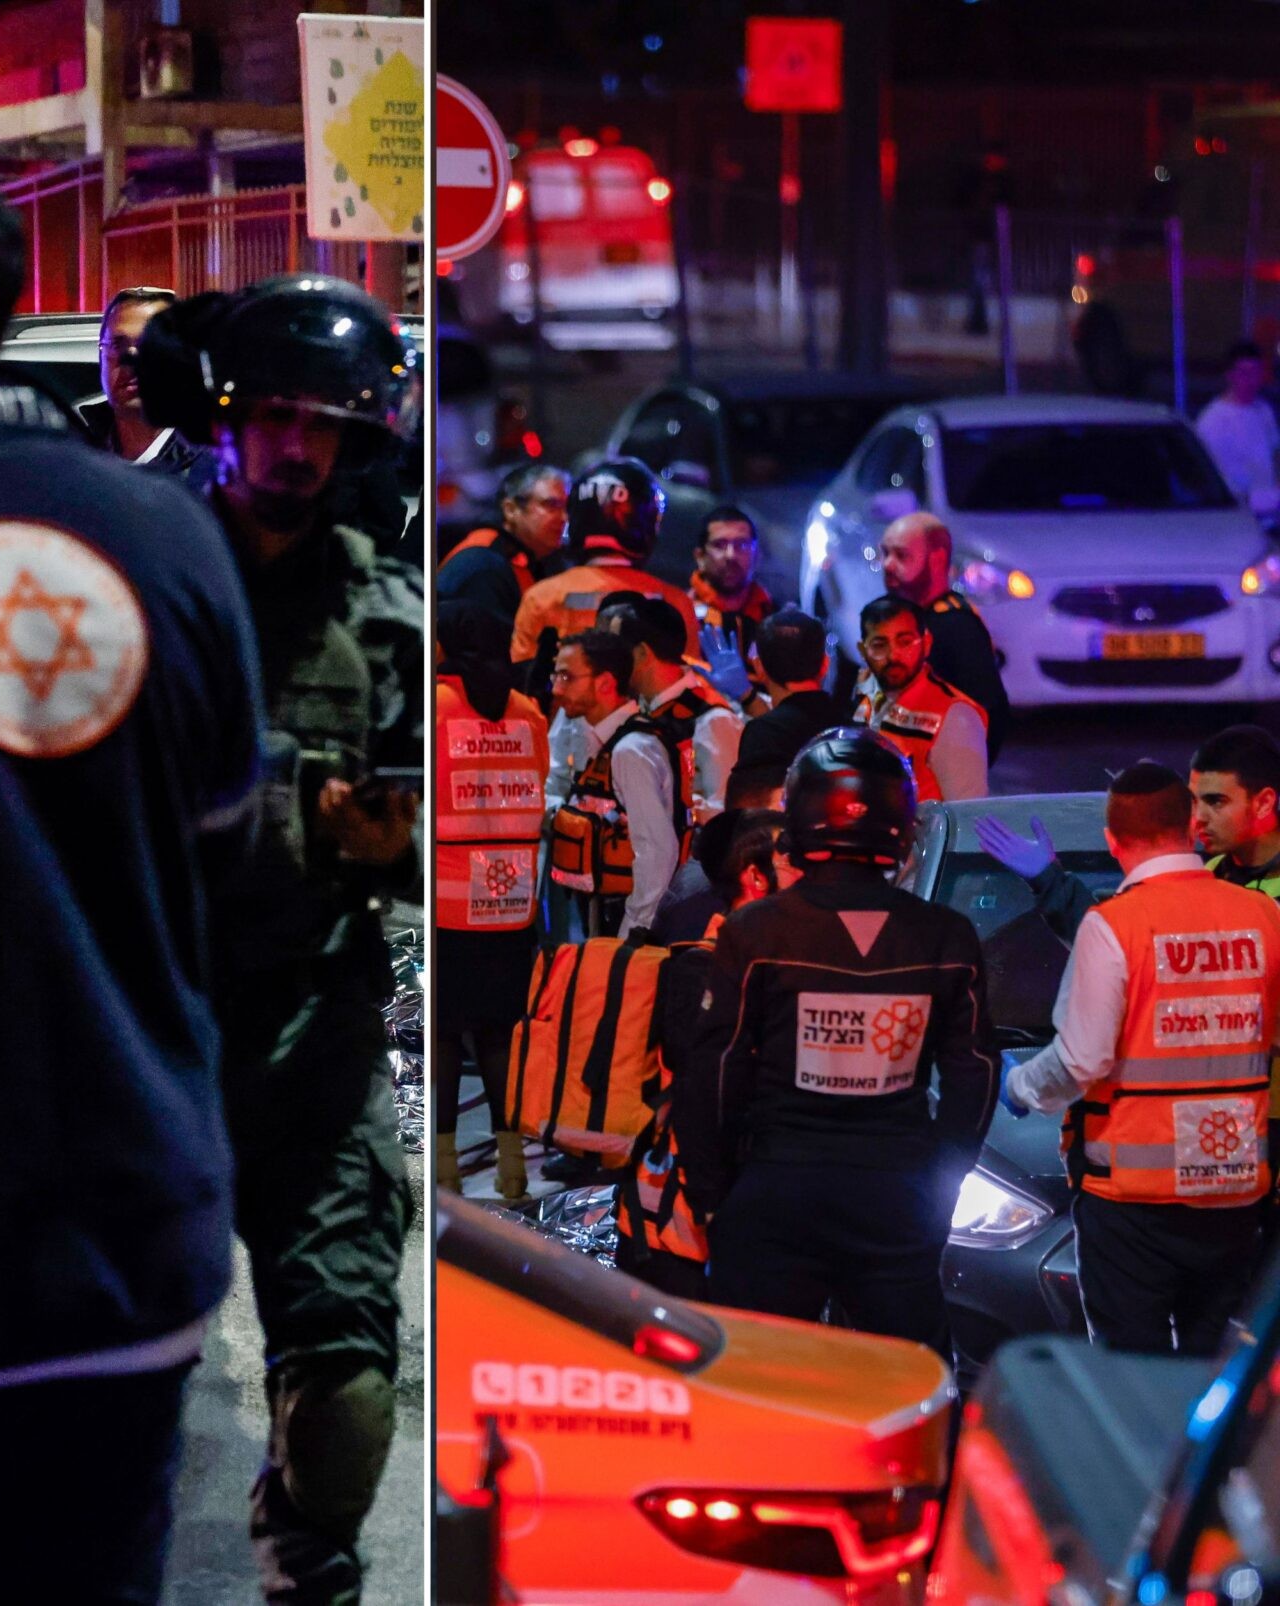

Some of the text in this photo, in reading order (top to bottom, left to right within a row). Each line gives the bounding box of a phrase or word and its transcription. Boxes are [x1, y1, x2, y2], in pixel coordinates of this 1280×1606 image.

[467, 737, 523, 754] אמבולנס
[457, 782, 535, 799] איחוד הצלה
[1165, 937, 1259, 975] חובש
[803, 1008, 866, 1026] איחוד
[1161, 1012, 1260, 1034] איחוד הצלה
[803, 1026, 865, 1045] הצלה
[800, 1072, 878, 1090] האופנועים
[1180, 1162, 1255, 1177] איחוד הצלה
